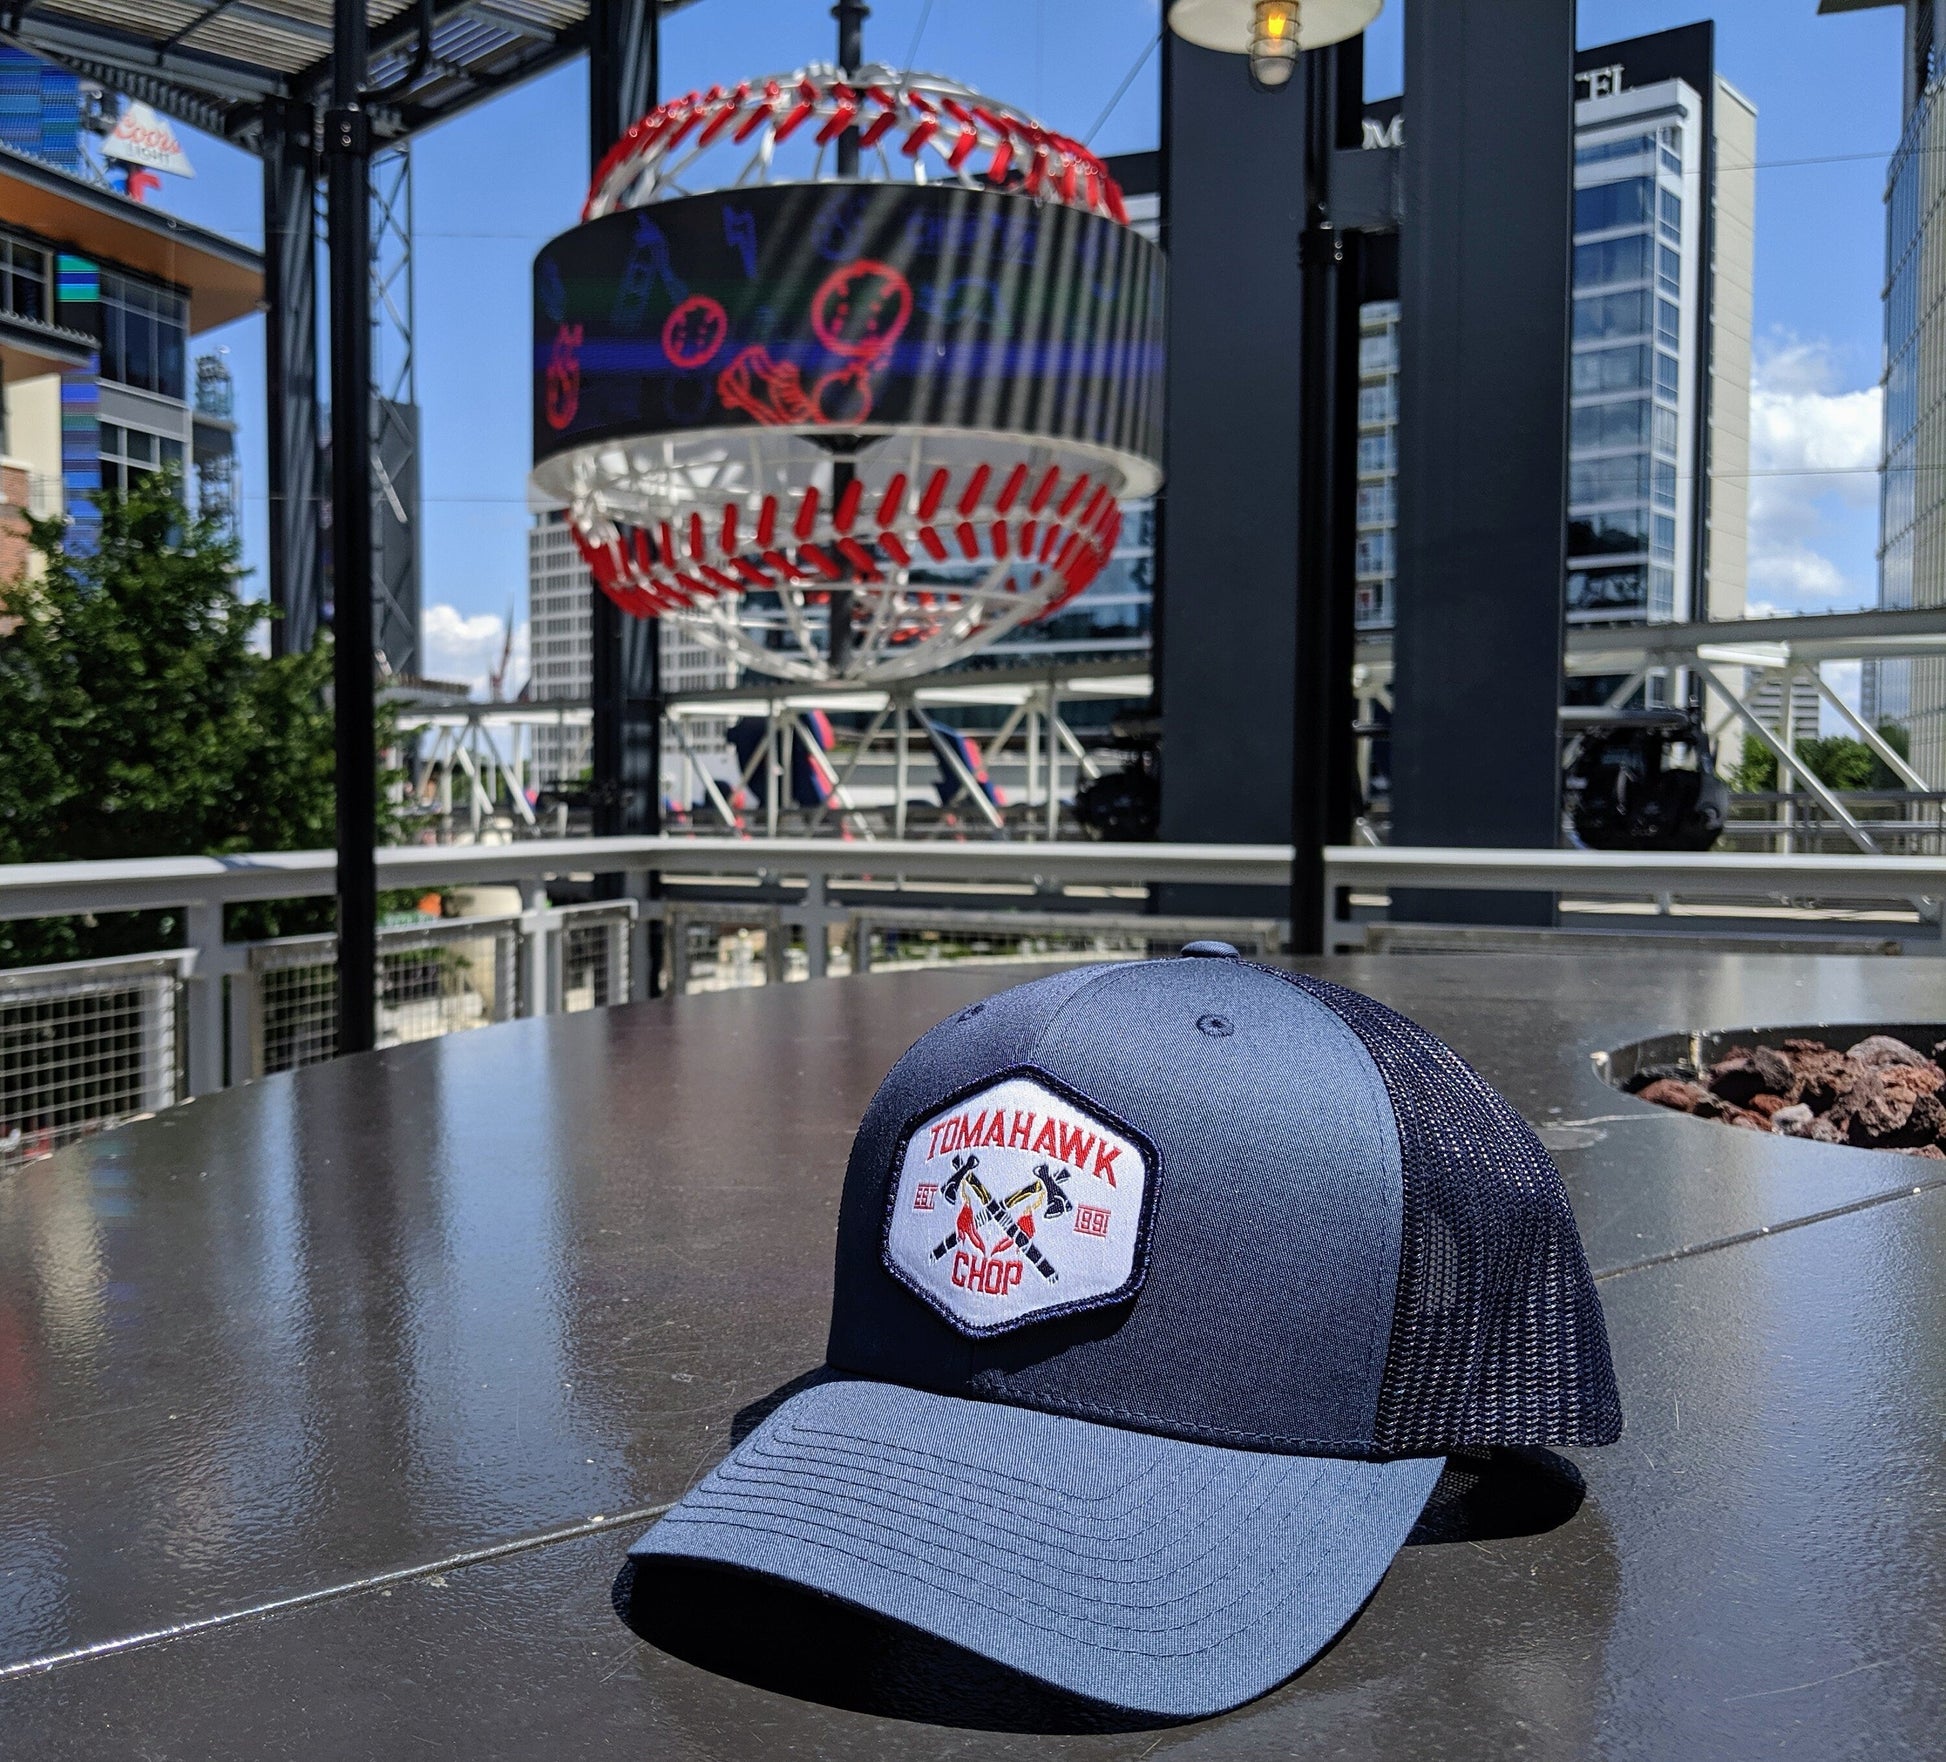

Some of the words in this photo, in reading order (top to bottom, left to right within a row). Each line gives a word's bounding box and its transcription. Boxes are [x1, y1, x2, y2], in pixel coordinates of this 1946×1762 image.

[114, 113, 181, 155] Coors
[926, 1109, 1122, 1188] TOMAHAWK
[914, 1186, 938, 1207] EST
[1074, 1207, 1109, 1234] 1991
[951, 1251, 1023, 1295] CHOP
